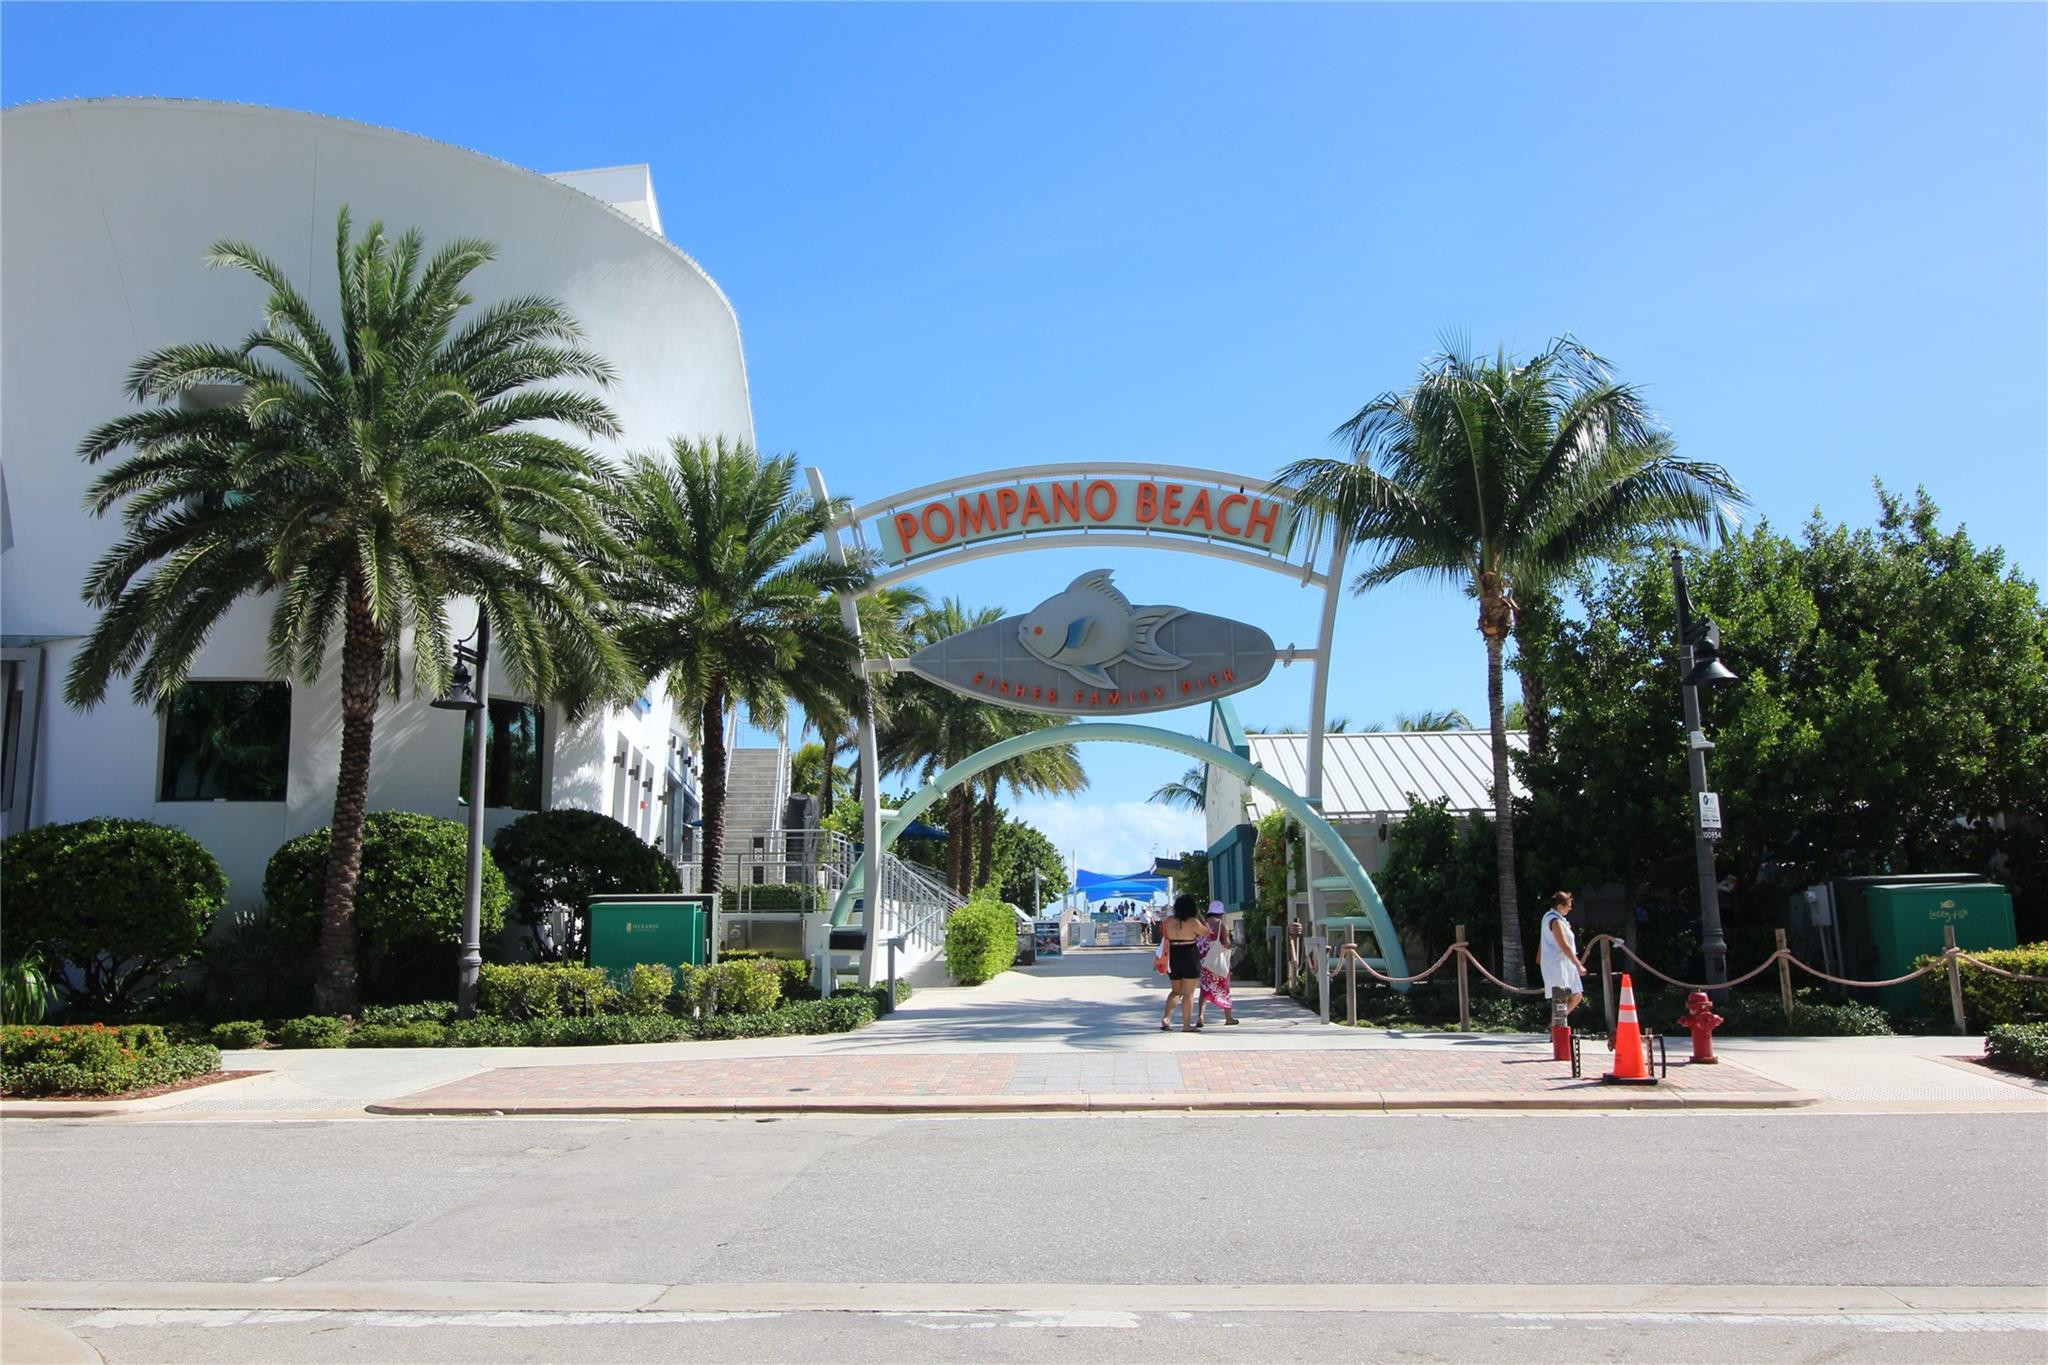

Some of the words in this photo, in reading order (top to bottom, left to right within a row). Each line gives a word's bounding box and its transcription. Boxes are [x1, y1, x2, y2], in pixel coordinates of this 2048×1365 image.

[894, 480, 1117, 553] POMPANO
[1136, 482, 1280, 543] BEACH
[972, 671, 1057, 704] FISHER
[1074, 687, 1165, 704] FAMILY
[1181, 667, 1236, 695] PIER
